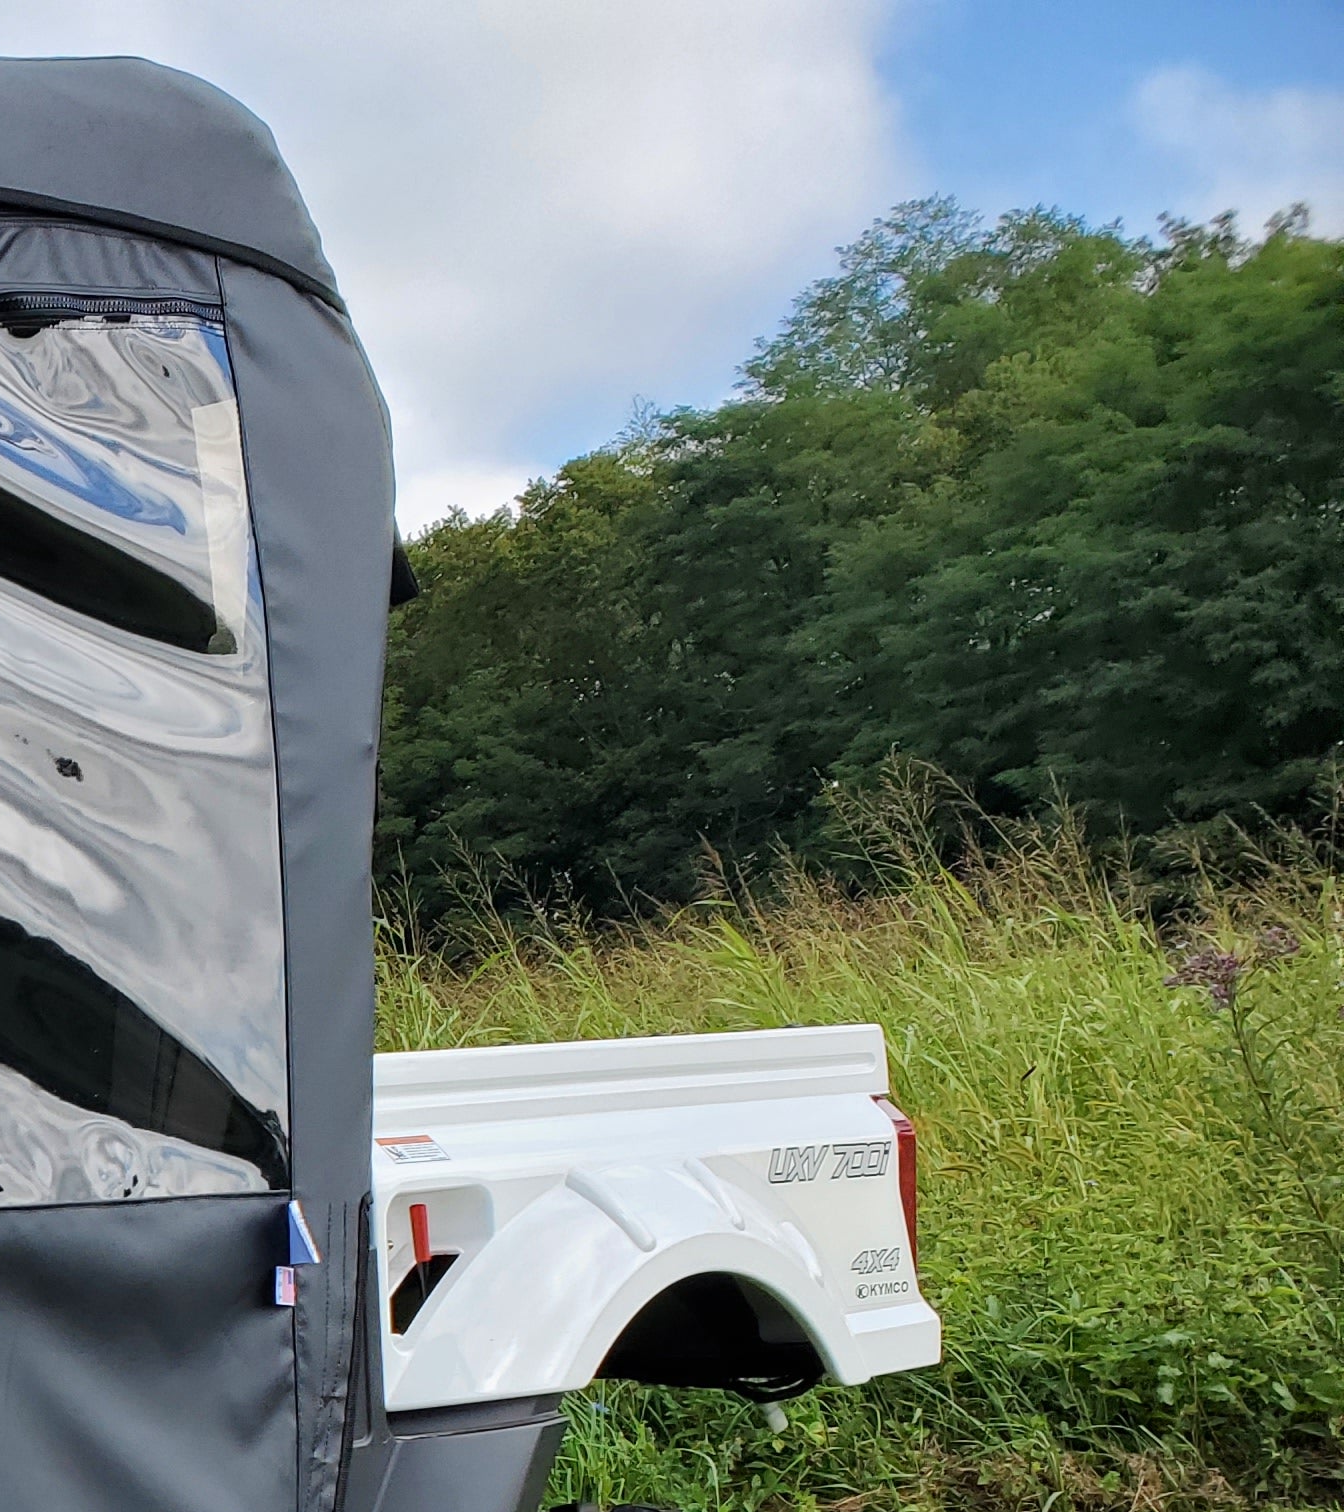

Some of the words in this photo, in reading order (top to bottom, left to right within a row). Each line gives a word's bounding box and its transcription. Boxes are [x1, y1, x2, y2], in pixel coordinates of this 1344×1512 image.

[768, 1144, 829, 1184] UXV
[831, 1141, 891, 1180] 700i
[851, 1248, 900, 1274] 4X4
[869, 1280, 909, 1297] KYMCO
